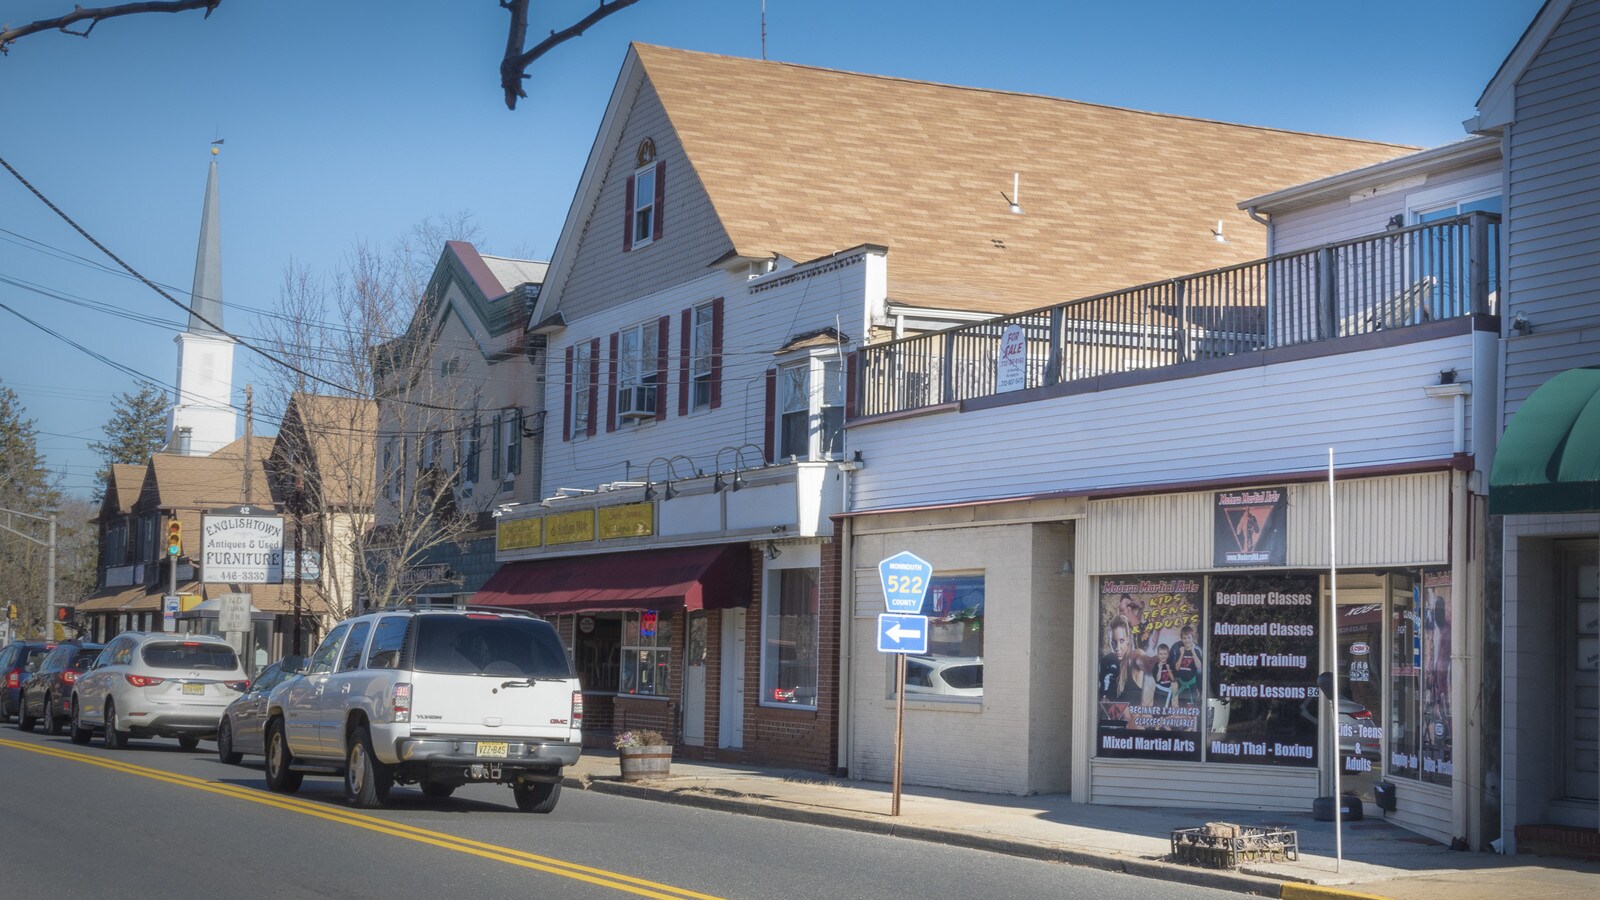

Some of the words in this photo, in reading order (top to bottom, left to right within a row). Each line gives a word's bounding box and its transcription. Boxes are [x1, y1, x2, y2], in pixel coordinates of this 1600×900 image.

[1003, 342, 1023, 359] SALE
[1265, 490, 1280, 502] Arts
[206, 519, 281, 537] ENGLISHTOWN
[208, 540, 246, 550] Antiques
[249, 540, 255, 549] &
[258, 541, 279, 549] Used
[206, 552, 280, 566] FURNITURE
[221, 571, 265, 580] 446-3330
[888, 575, 922, 594] 522
[1102, 580, 1138, 594] Modern
[1139, 580, 1174, 594] Martial
[1176, 580, 1198, 593] Arts
[228, 596, 242, 604] NO
[1150, 594, 1181, 606] KIDS
[1216, 592, 1266, 606] Beginner
[1268, 592, 1312, 605] Classes
[1142, 604, 1188, 619] TEENS
[1131, 625, 1140, 634] &
[1145, 614, 1199, 631] ADULTS
[1214, 622, 1267, 636] Advanced
[1269, 622, 1314, 636] Classes
[1220, 653, 1258, 668] Fighter
[1260, 654, 1307, 669] Training
[1220, 684, 1256, 697] Private
[1260, 685, 1305, 698] Lessons
[1130, 706, 1160, 714] BEGINNER
[1162, 707, 1166, 715] &
[1168, 708, 1200, 716] ADVANCED
[1135, 718, 1160, 726] CLASSES
[1160, 718, 1194, 727] AVAILABLE
[1358, 724, 1382, 738] Teens
[1103, 736, 1133, 750] Mixed
[1135, 737, 1171, 750] Martial
[1174, 739, 1195, 752] Arts
[1212, 741, 1240, 756] Muay
[1242, 742, 1266, 756] Thai
[1275, 743, 1313, 758] Boxing
[1355, 742, 1361, 754] &
[1345, 756, 1371, 771] Adults
